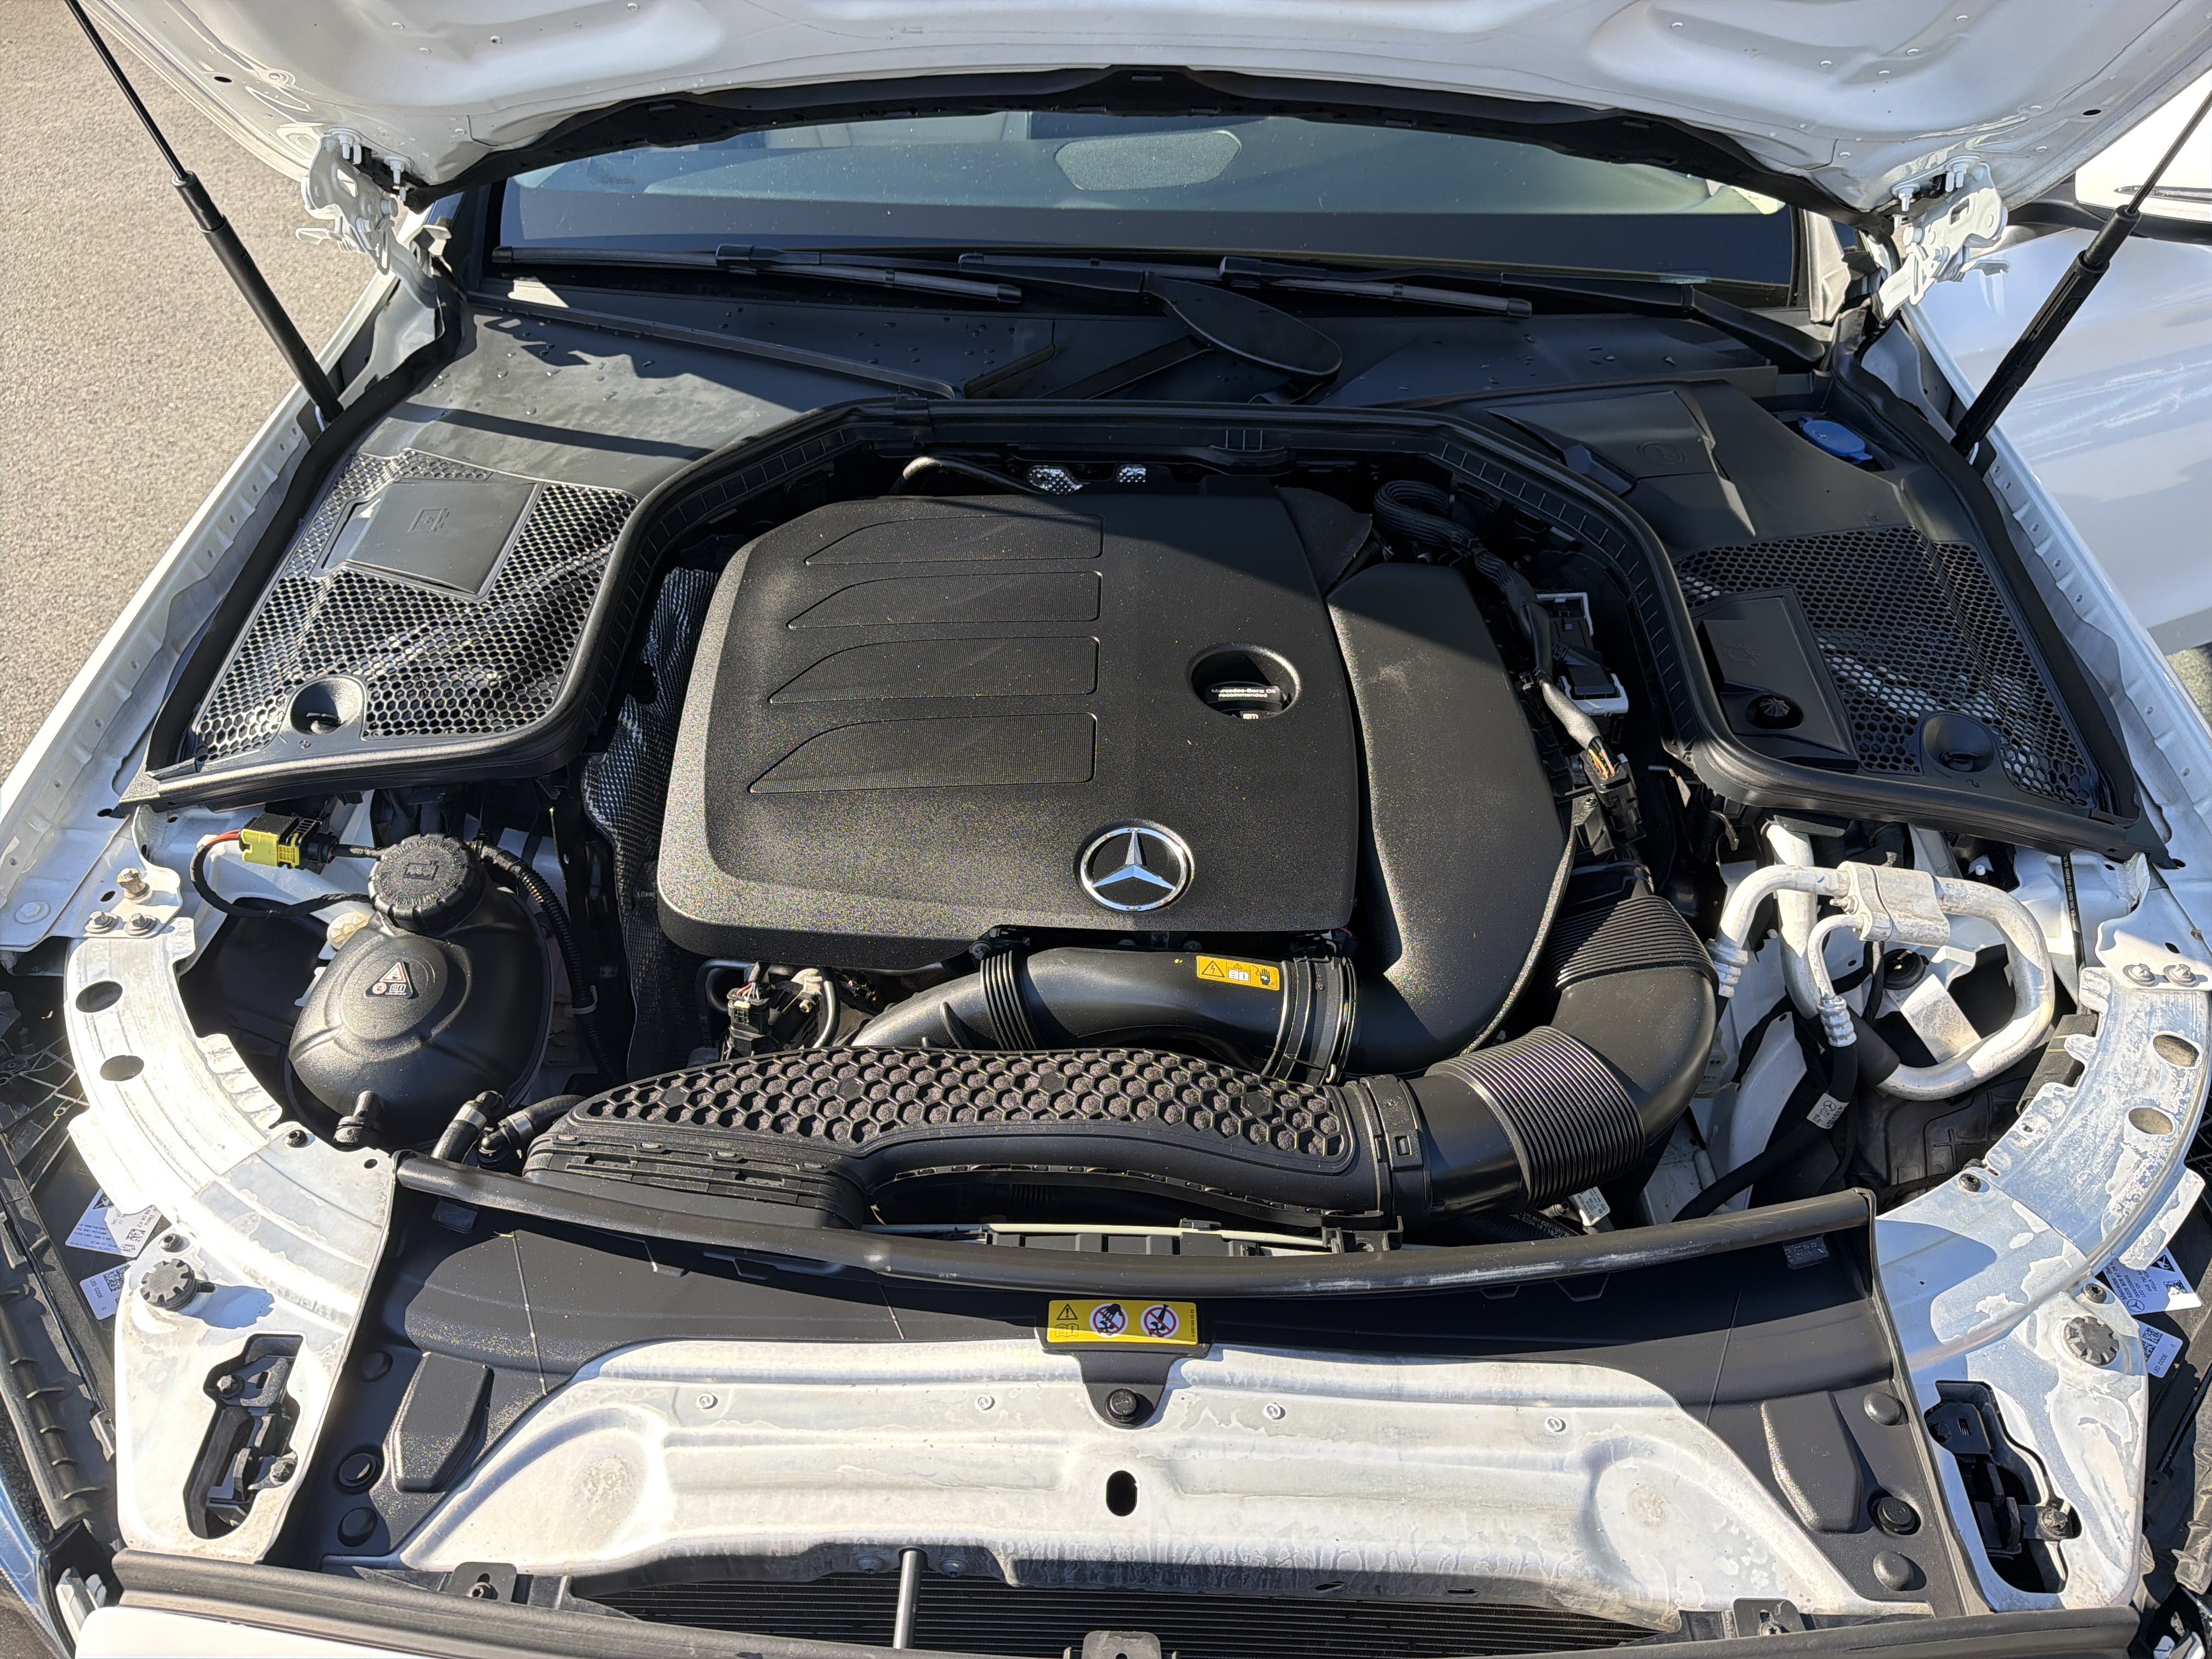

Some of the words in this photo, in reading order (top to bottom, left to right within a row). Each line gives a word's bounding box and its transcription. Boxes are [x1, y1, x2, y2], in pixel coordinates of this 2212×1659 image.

[1820, 1108, 1830, 1117] CTK
[94, 1287, 103, 1299] CODE
[2112, 1278, 2128, 1300] Mercedes
[2152, 1365, 2160, 1374] LED
[2158, 1353, 2168, 1365] CODE
